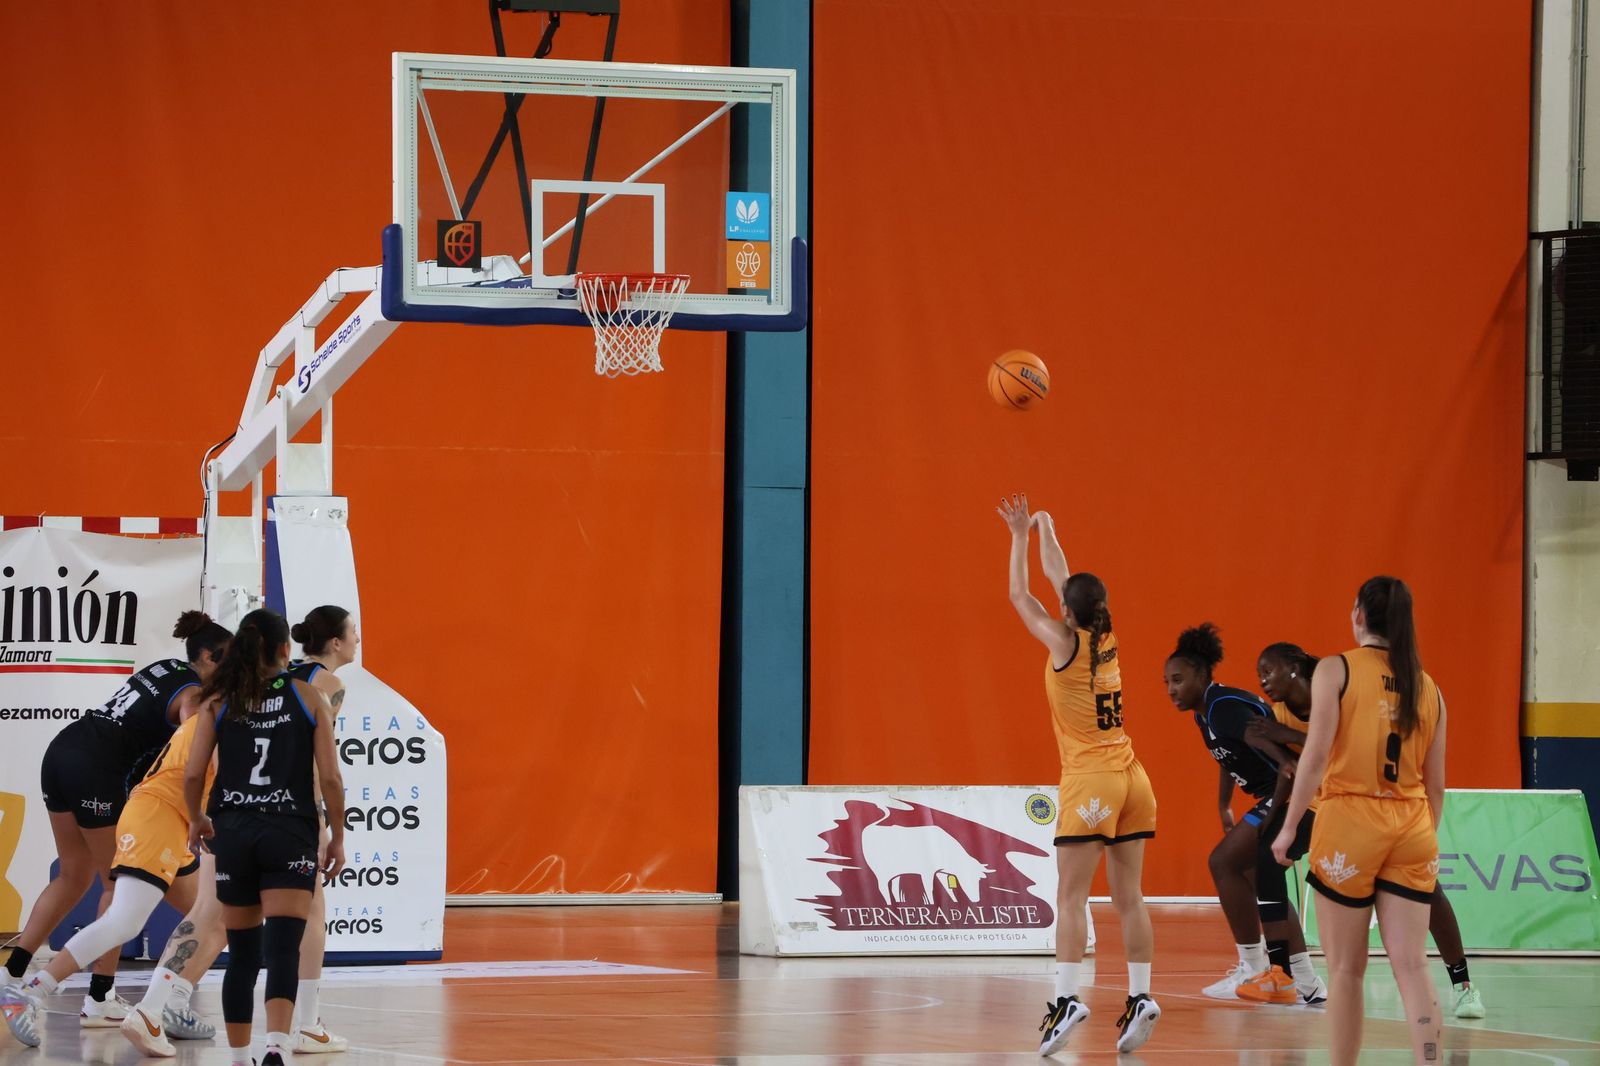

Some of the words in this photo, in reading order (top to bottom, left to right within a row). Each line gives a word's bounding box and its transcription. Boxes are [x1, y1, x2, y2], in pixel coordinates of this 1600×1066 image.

[310, 339, 338, 373] Schelde
[338, 315, 361, 344] Sports
[0, 646, 52, 663] Zamora
[1095, 690, 1123, 731] 55
[338, 716, 425, 731] TEAS
[248, 737, 271, 786] 2
[335, 737, 426, 765] eros
[1383, 732, 1402, 783] 9
[334, 906, 383, 916] TEAS
[840, 906, 950, 926] TERNERA
[963, 905, 1041, 924] ALISTE
[325, 918, 383, 935] reros
[864, 934, 917, 943] INDICACIÓN
[919, 934, 975, 942] GEOGRÁFICA
[977, 933, 1027, 941] PROTEGIDA
